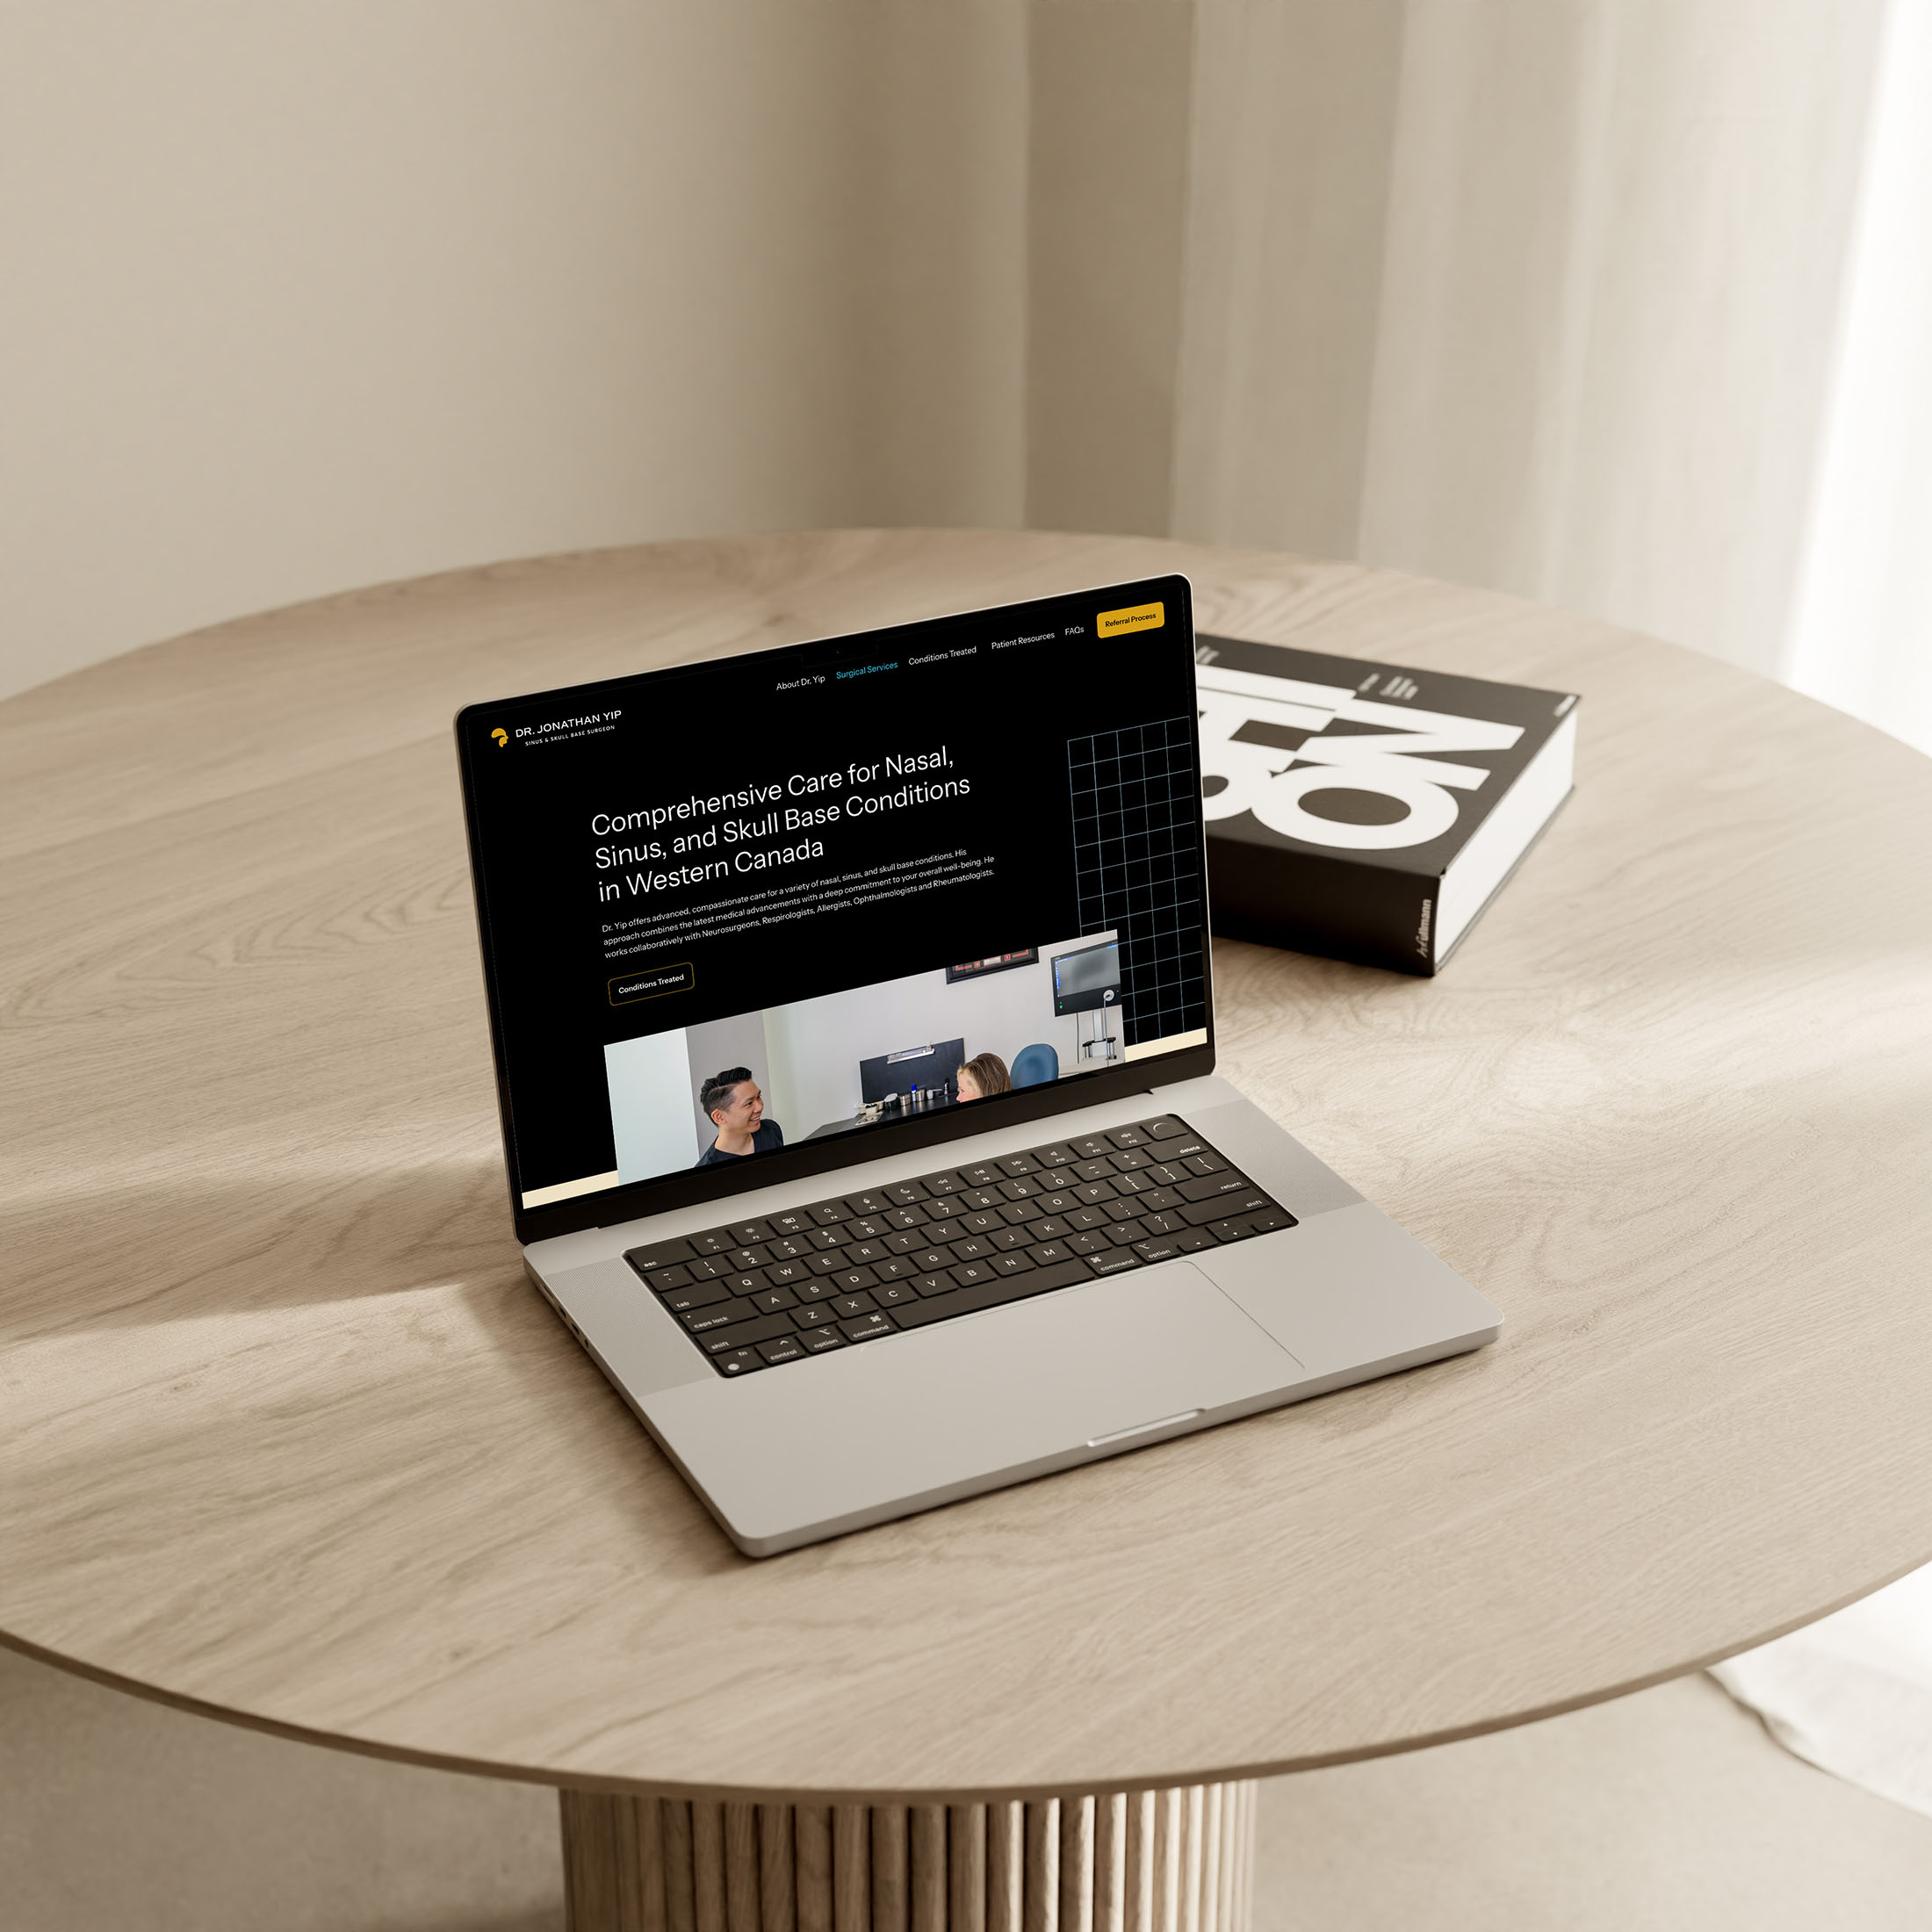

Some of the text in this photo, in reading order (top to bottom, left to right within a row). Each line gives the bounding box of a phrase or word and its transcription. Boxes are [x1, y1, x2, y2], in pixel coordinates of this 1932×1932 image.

[1105, 613, 1157, 628] Referral Process
[1064, 626, 1085, 636] FAQs
[991, 632, 1056, 650] Patient Resources
[908, 645, 977, 666] Conditions Treated
[836, 662, 898, 680] Surgical Services
[775, 680, 800, 691] About
[812, 674, 825, 684] Yip
[515, 710, 622, 738] DR. JONATHAN YIP
[587, 724, 615, 735] SURGEON
[591, 745, 954, 836] Comprehensive Care for Nasal,
[595, 778, 970, 869] Sinus, and Skull Base Conditions
[598, 838, 824, 903] in Western Canada
[614, 921, 628, 930] Yip
[628, 917, 652, 927] offers
[652, 907, 691, 922] advanced,
[691, 896, 749, 913] compassionate
[749, 892, 767, 901] care
[784, 883, 811, 893] variety
[811, 879, 818, 888] of
[819, 876, 841, 886] nasal,
[842, 872, 863, 882] sinus,
[863, 867, 878, 877] and
[878, 863, 896, 874] skull
[896, 861, 914, 869] base
[914, 853, 955, 866] conditions.
[955, 848, 967, 857] His
[603, 931, 640, 947] approach
[640, 924, 679, 938] combines
[693, 916, 715, 926] latest
[715, 908, 746, 921] medical
[746, 898, 801, 915] advancements
[801, 893, 818, 903] with
[824, 889, 844, 898] deep
[844, 878, 892, 894] commitment
[901, 873, 918, 883] your
[918, 866, 942, 878] overall
[942, 859, 983, 872] well-being.
[604, 869, 994, 959] works collaboratively with Neurosurgeons, Respirologists, Allergists, Ophthalmologists and Rheumatologists.
[618, 973, 685, 994] Conditions Treated
[1148, 1249, 1171, 1259] option
[1099, 1258, 1135, 1272] command
[693, 1316, 729, 1330] caps lock
[853, 1324, 890, 1337] command
[813, 1337, 840, 1351] option
[770, 1350, 797, 1359] control
